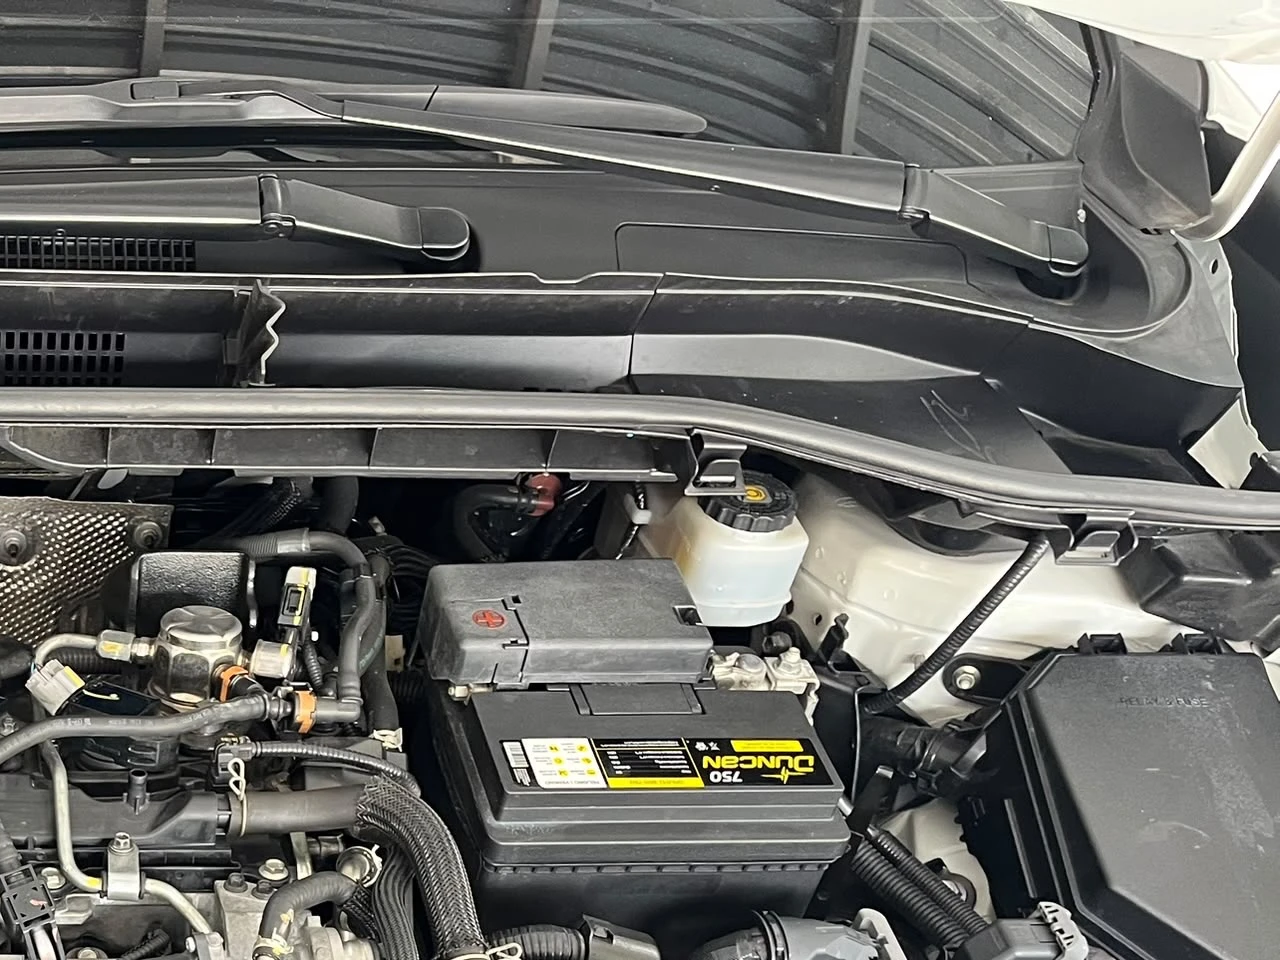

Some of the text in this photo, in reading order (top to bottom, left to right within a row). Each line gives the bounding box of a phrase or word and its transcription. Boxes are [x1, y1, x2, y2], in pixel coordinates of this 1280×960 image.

[1176, 696, 1210, 708] FUSE
[702, 755, 815, 773] DUNCAN
[709, 770, 743, 783] 750
